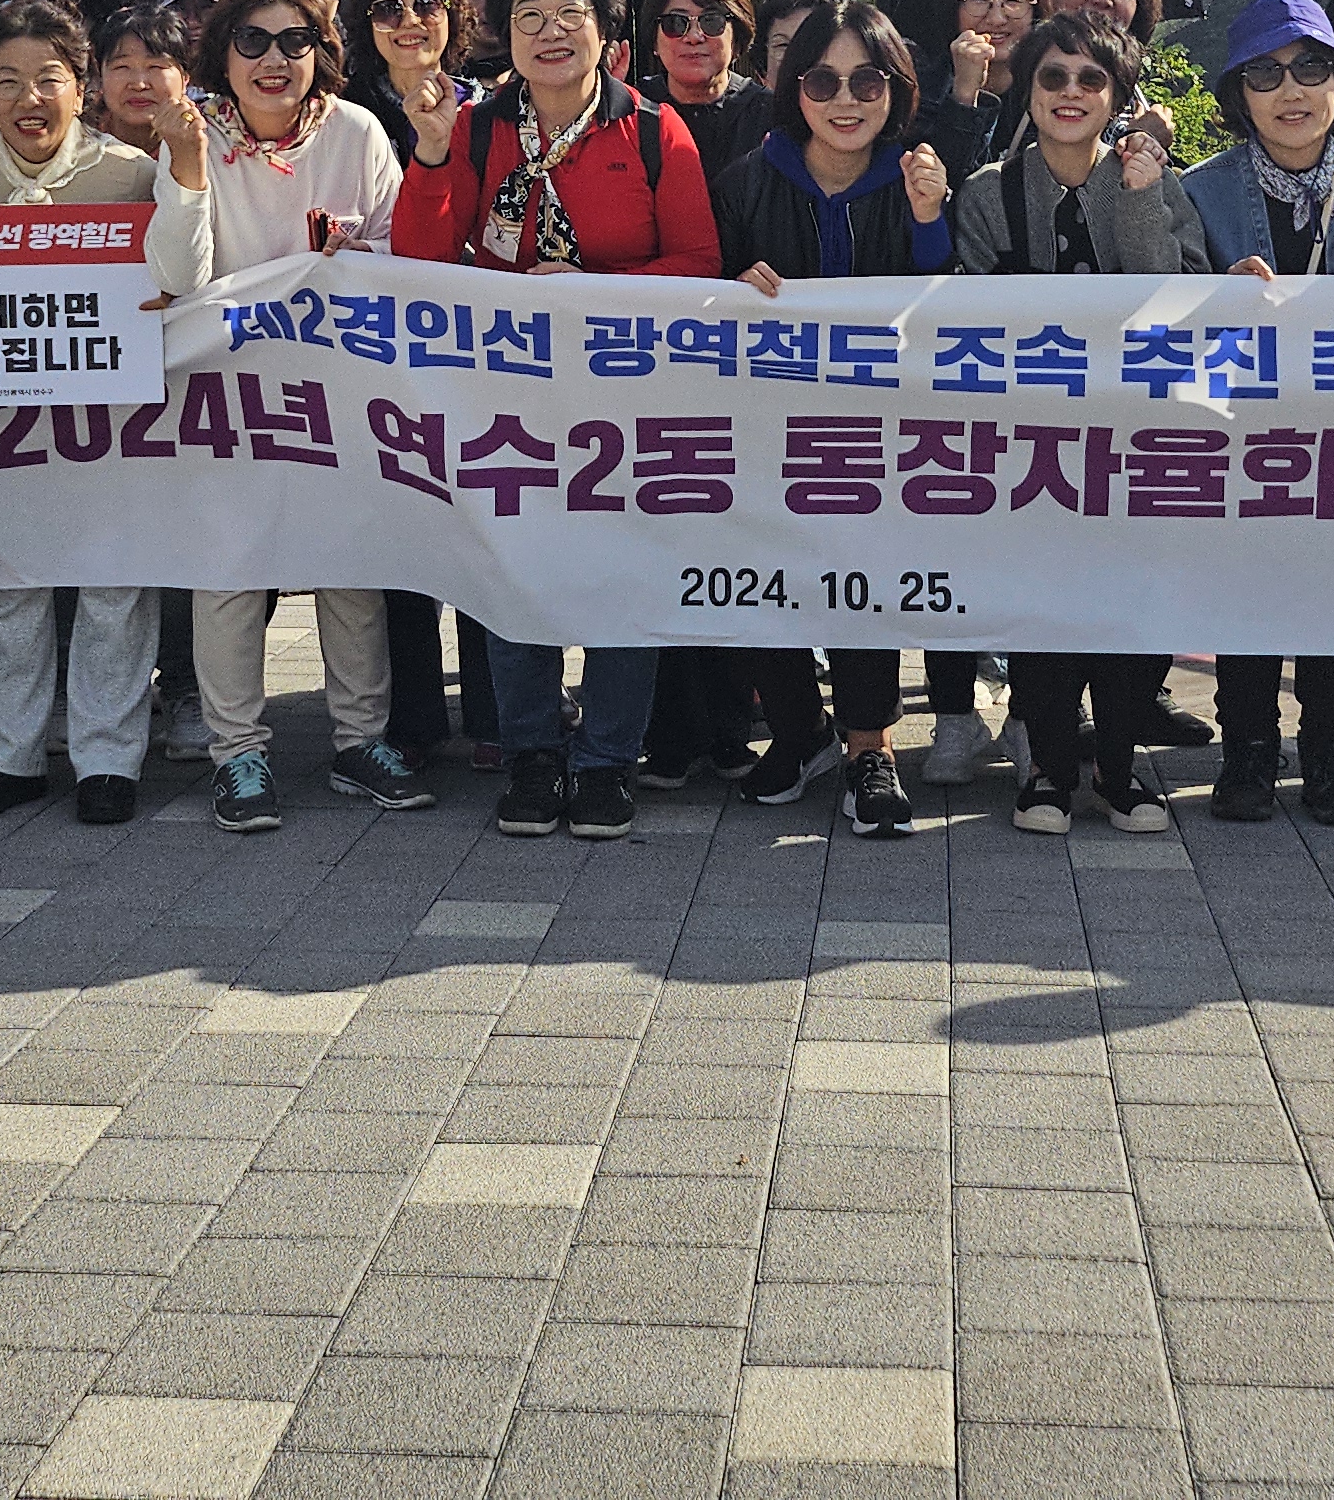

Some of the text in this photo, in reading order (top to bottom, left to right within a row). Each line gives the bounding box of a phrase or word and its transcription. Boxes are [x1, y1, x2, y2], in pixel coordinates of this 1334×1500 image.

[28, 222, 133, 249] 광역철도
[222, 287, 553, 379] 제2경인선
[584, 315, 902, 389] 광역철도
[932, 325, 1088, 398] 조속
[1121, 325, 1279, 400] 추진
[368, 398, 737, 517] 연수2동
[680, 567, 967, 614] 2024. 10. 25.
